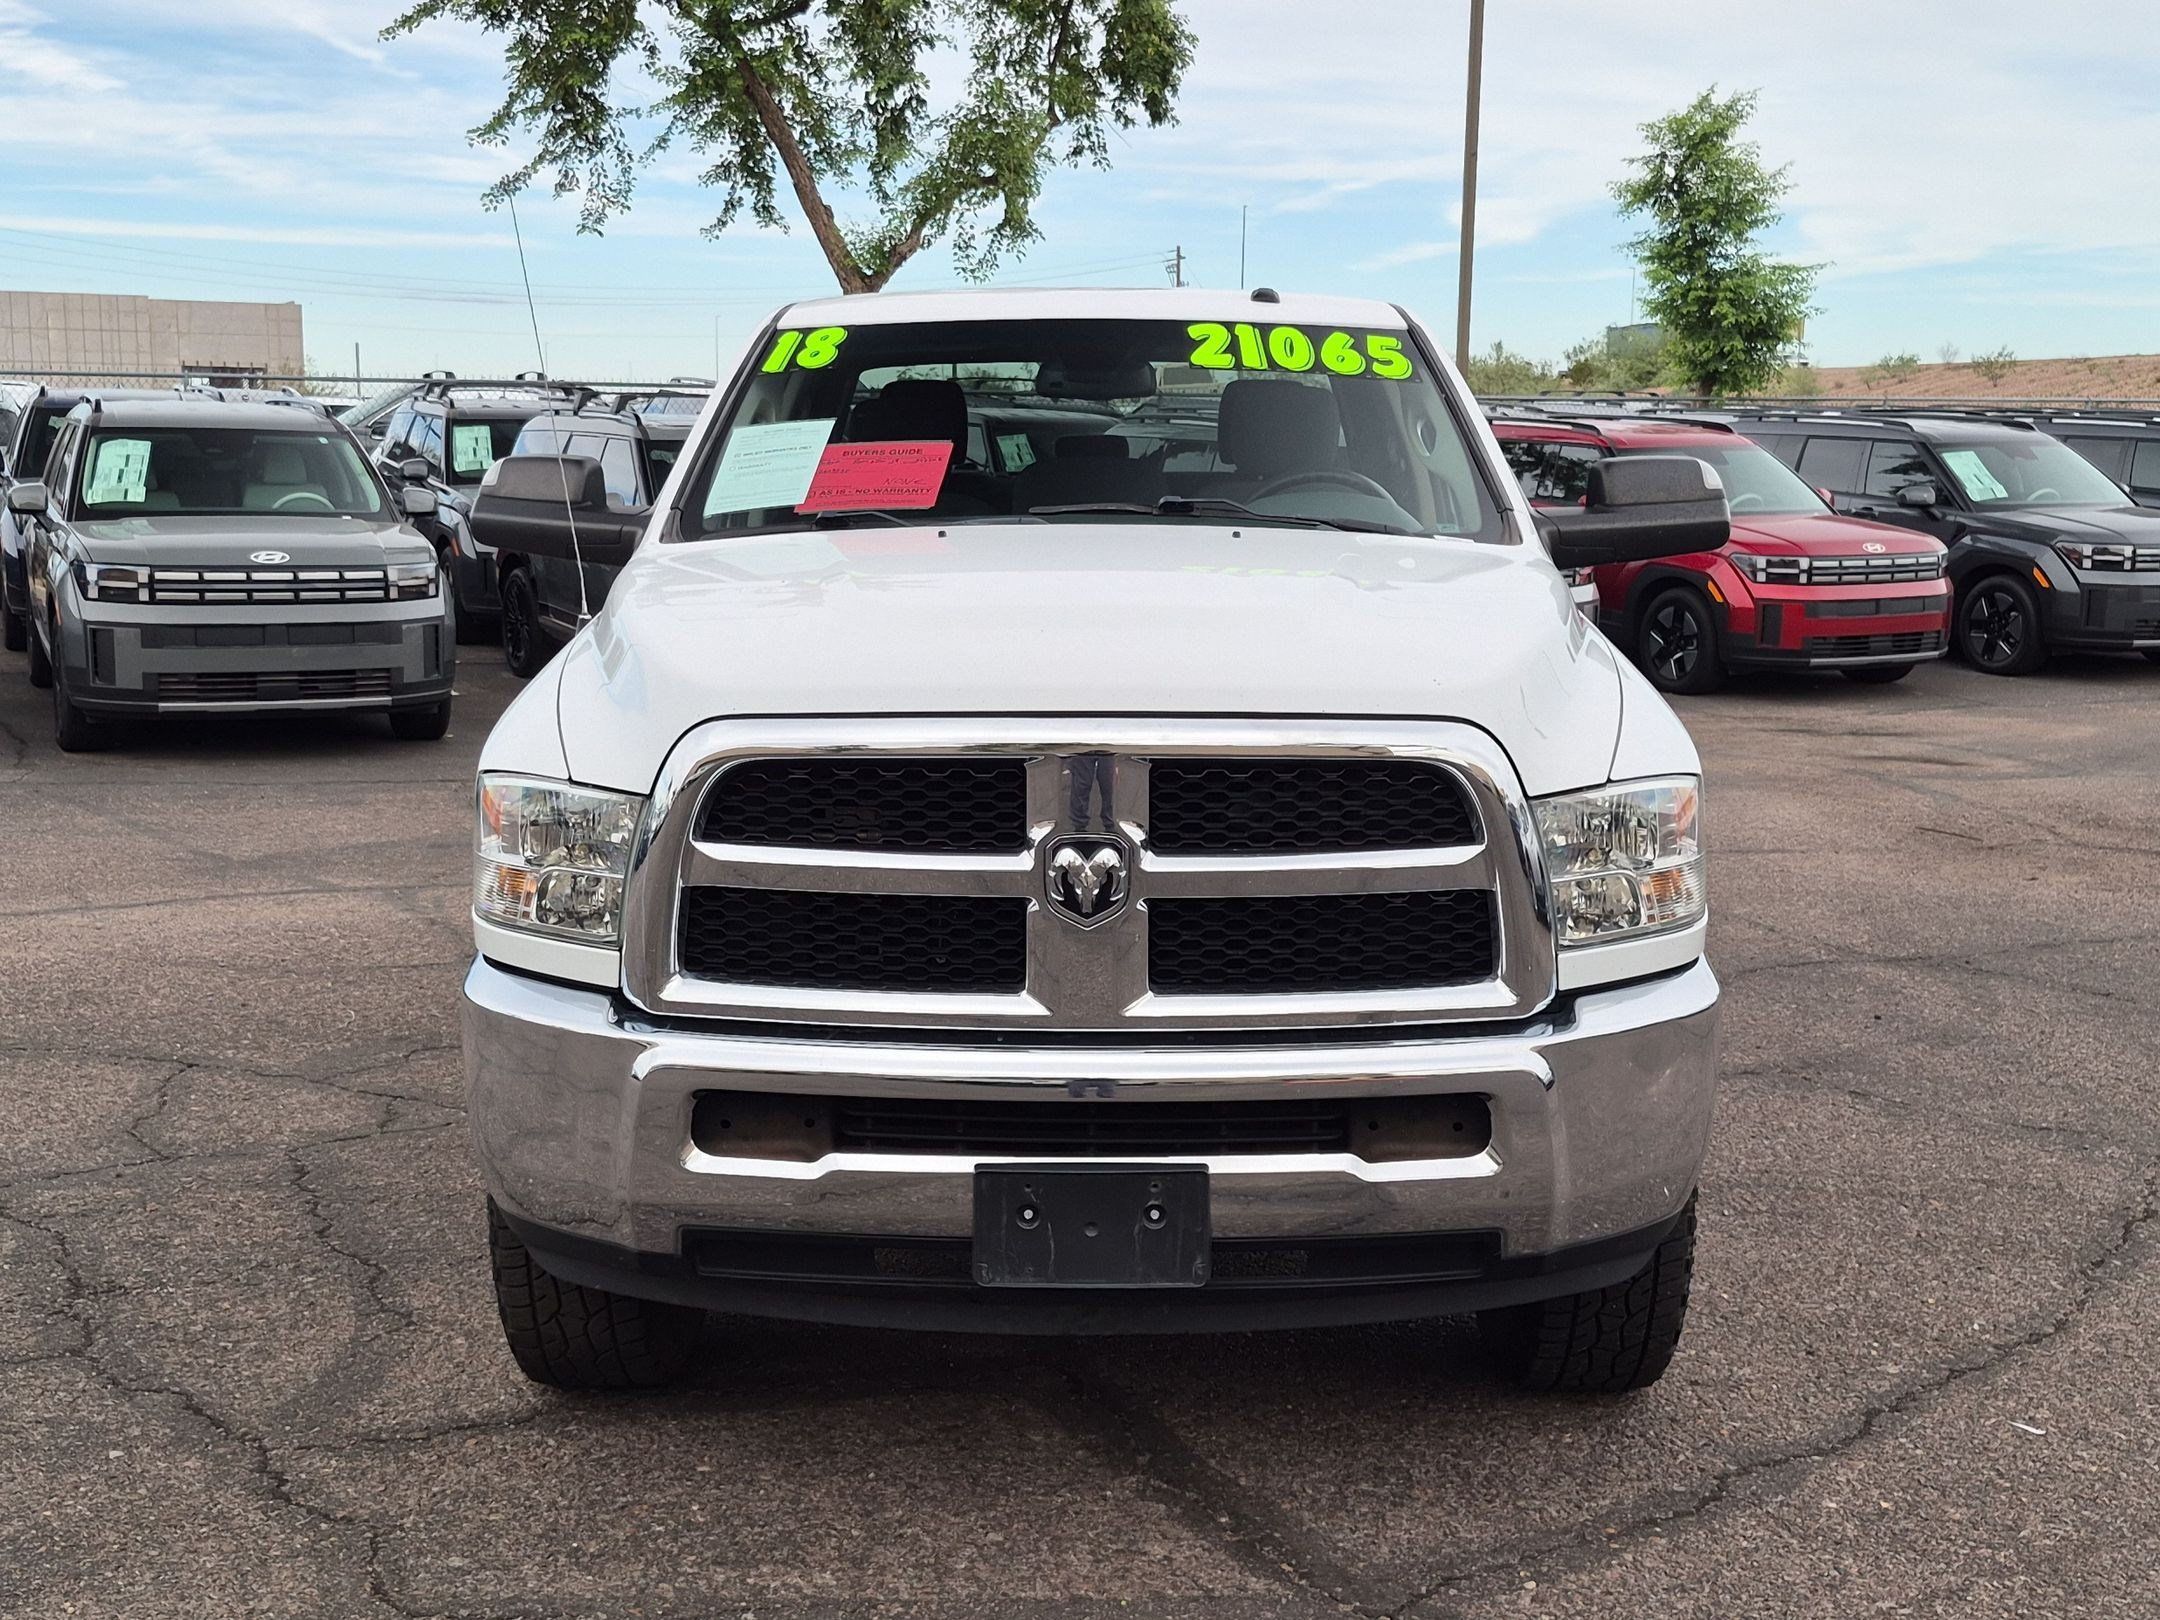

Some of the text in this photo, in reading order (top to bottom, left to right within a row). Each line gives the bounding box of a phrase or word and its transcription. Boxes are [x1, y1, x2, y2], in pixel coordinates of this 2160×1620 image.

[761, 327, 848, 373] 18
[1187, 323, 1413, 380] 21065
[842, 449, 886, 457] BUYERS
